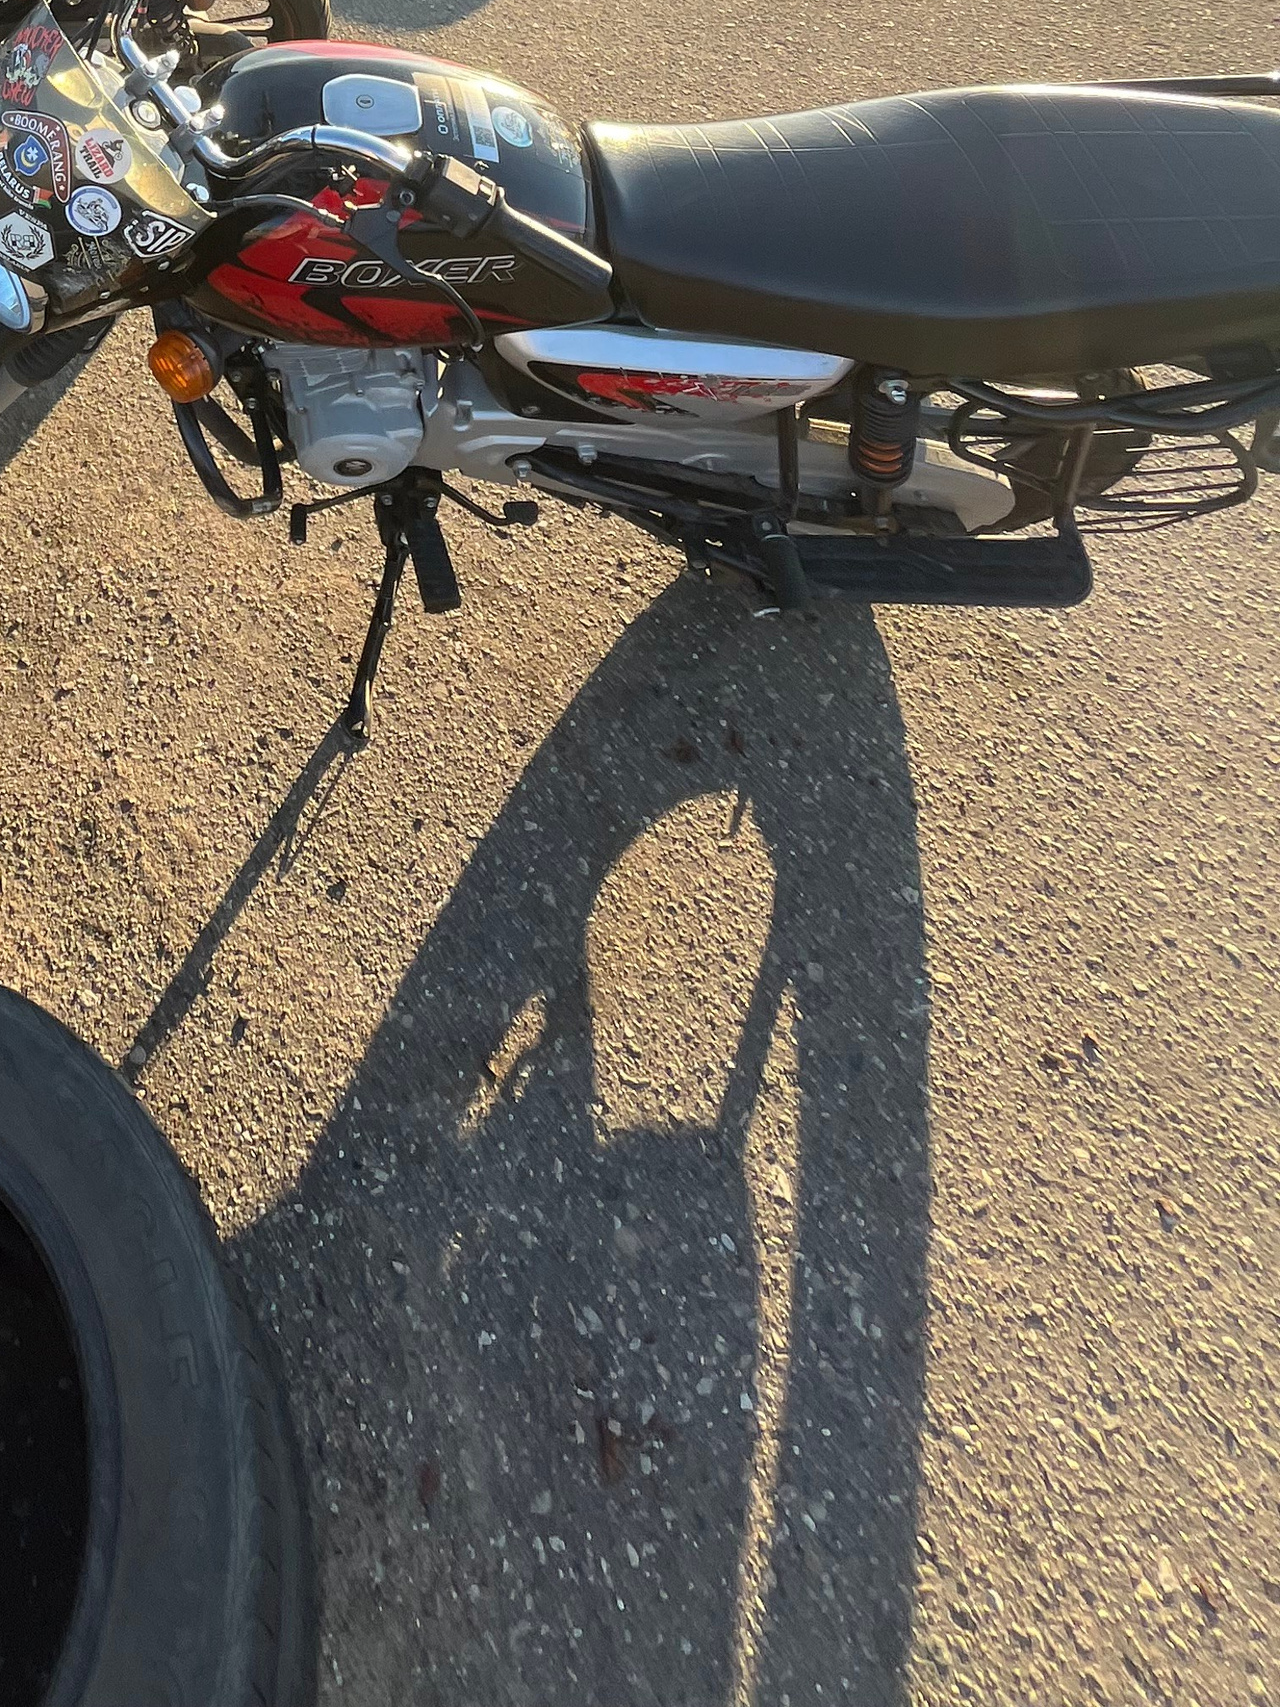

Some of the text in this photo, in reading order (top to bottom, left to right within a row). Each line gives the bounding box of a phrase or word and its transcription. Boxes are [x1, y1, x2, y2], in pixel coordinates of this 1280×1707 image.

[14, 114, 67, 182] BOOMERANG
[79, 145, 102, 179] TRAIL
[85, 137, 114, 178] LIZARD
[288, 255, 516, 288] BOXER
